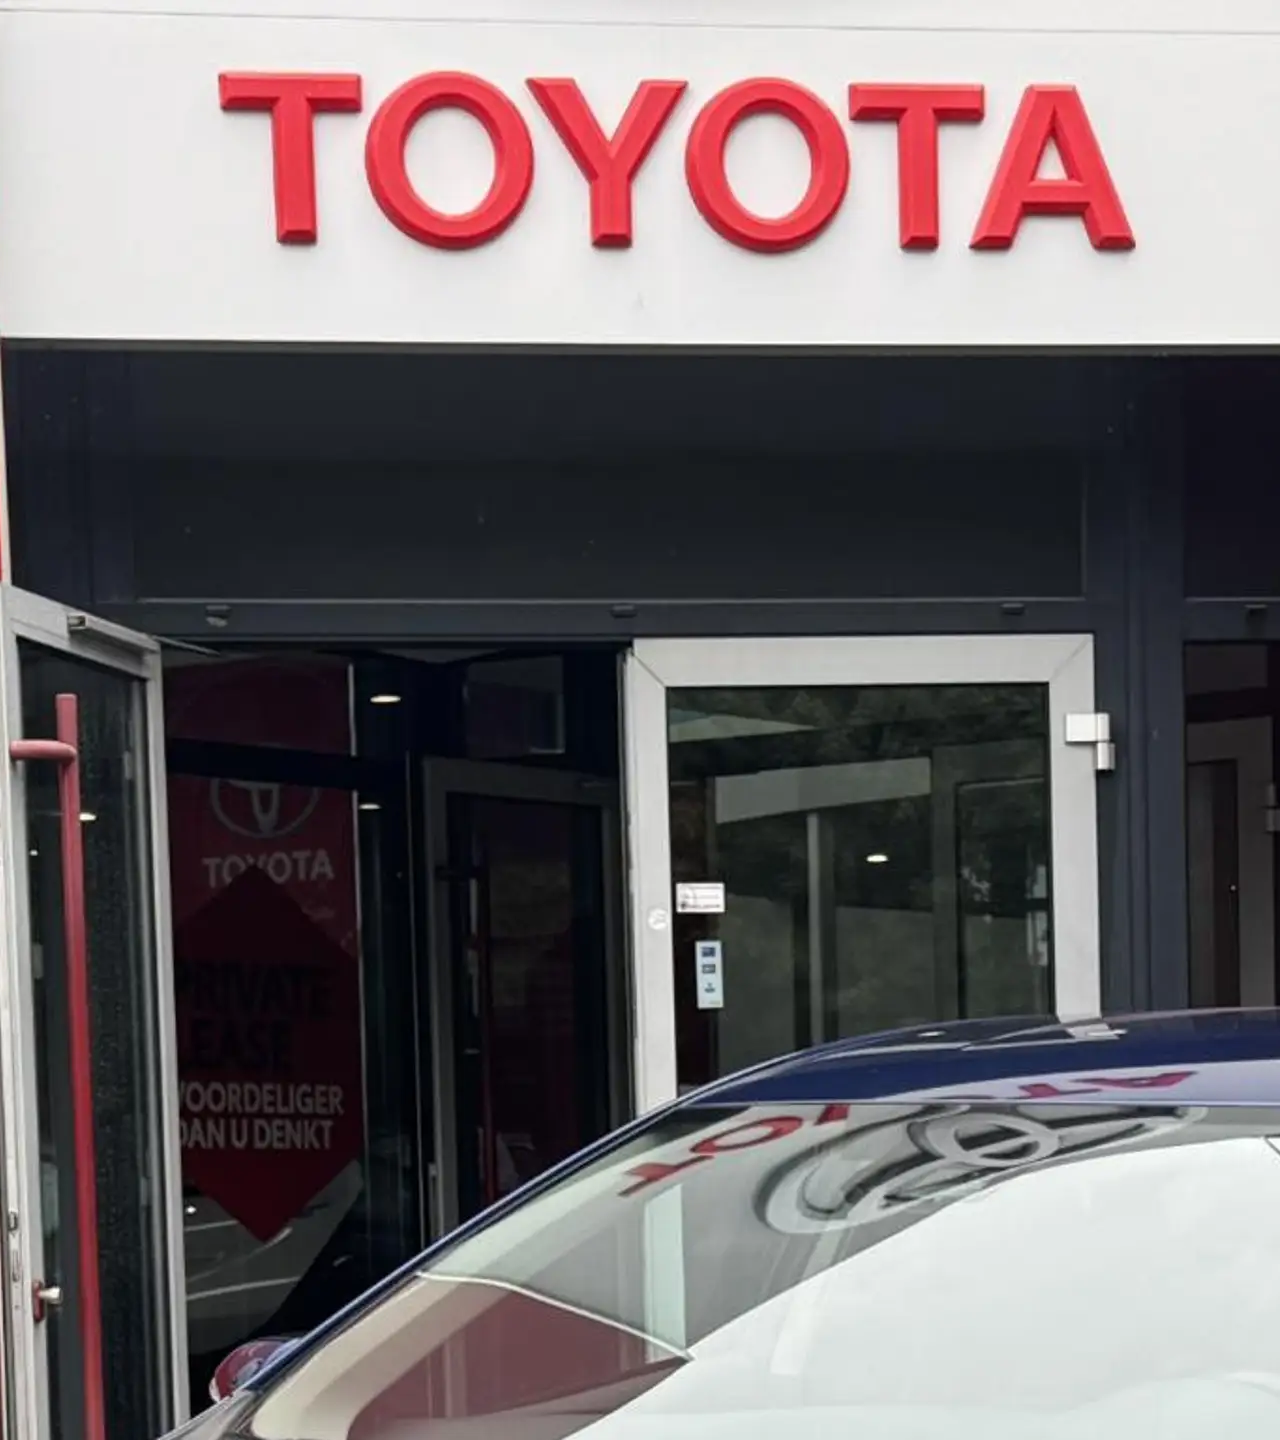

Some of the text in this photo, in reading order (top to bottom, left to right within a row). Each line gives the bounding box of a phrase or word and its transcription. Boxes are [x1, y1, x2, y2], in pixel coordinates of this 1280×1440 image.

[218, 70, 1136, 254] TOYOTA
[180, 1020, 291, 1070] EASE
[230, 1118, 249, 1149] U
[253, 1118, 334, 1150] DENKT
